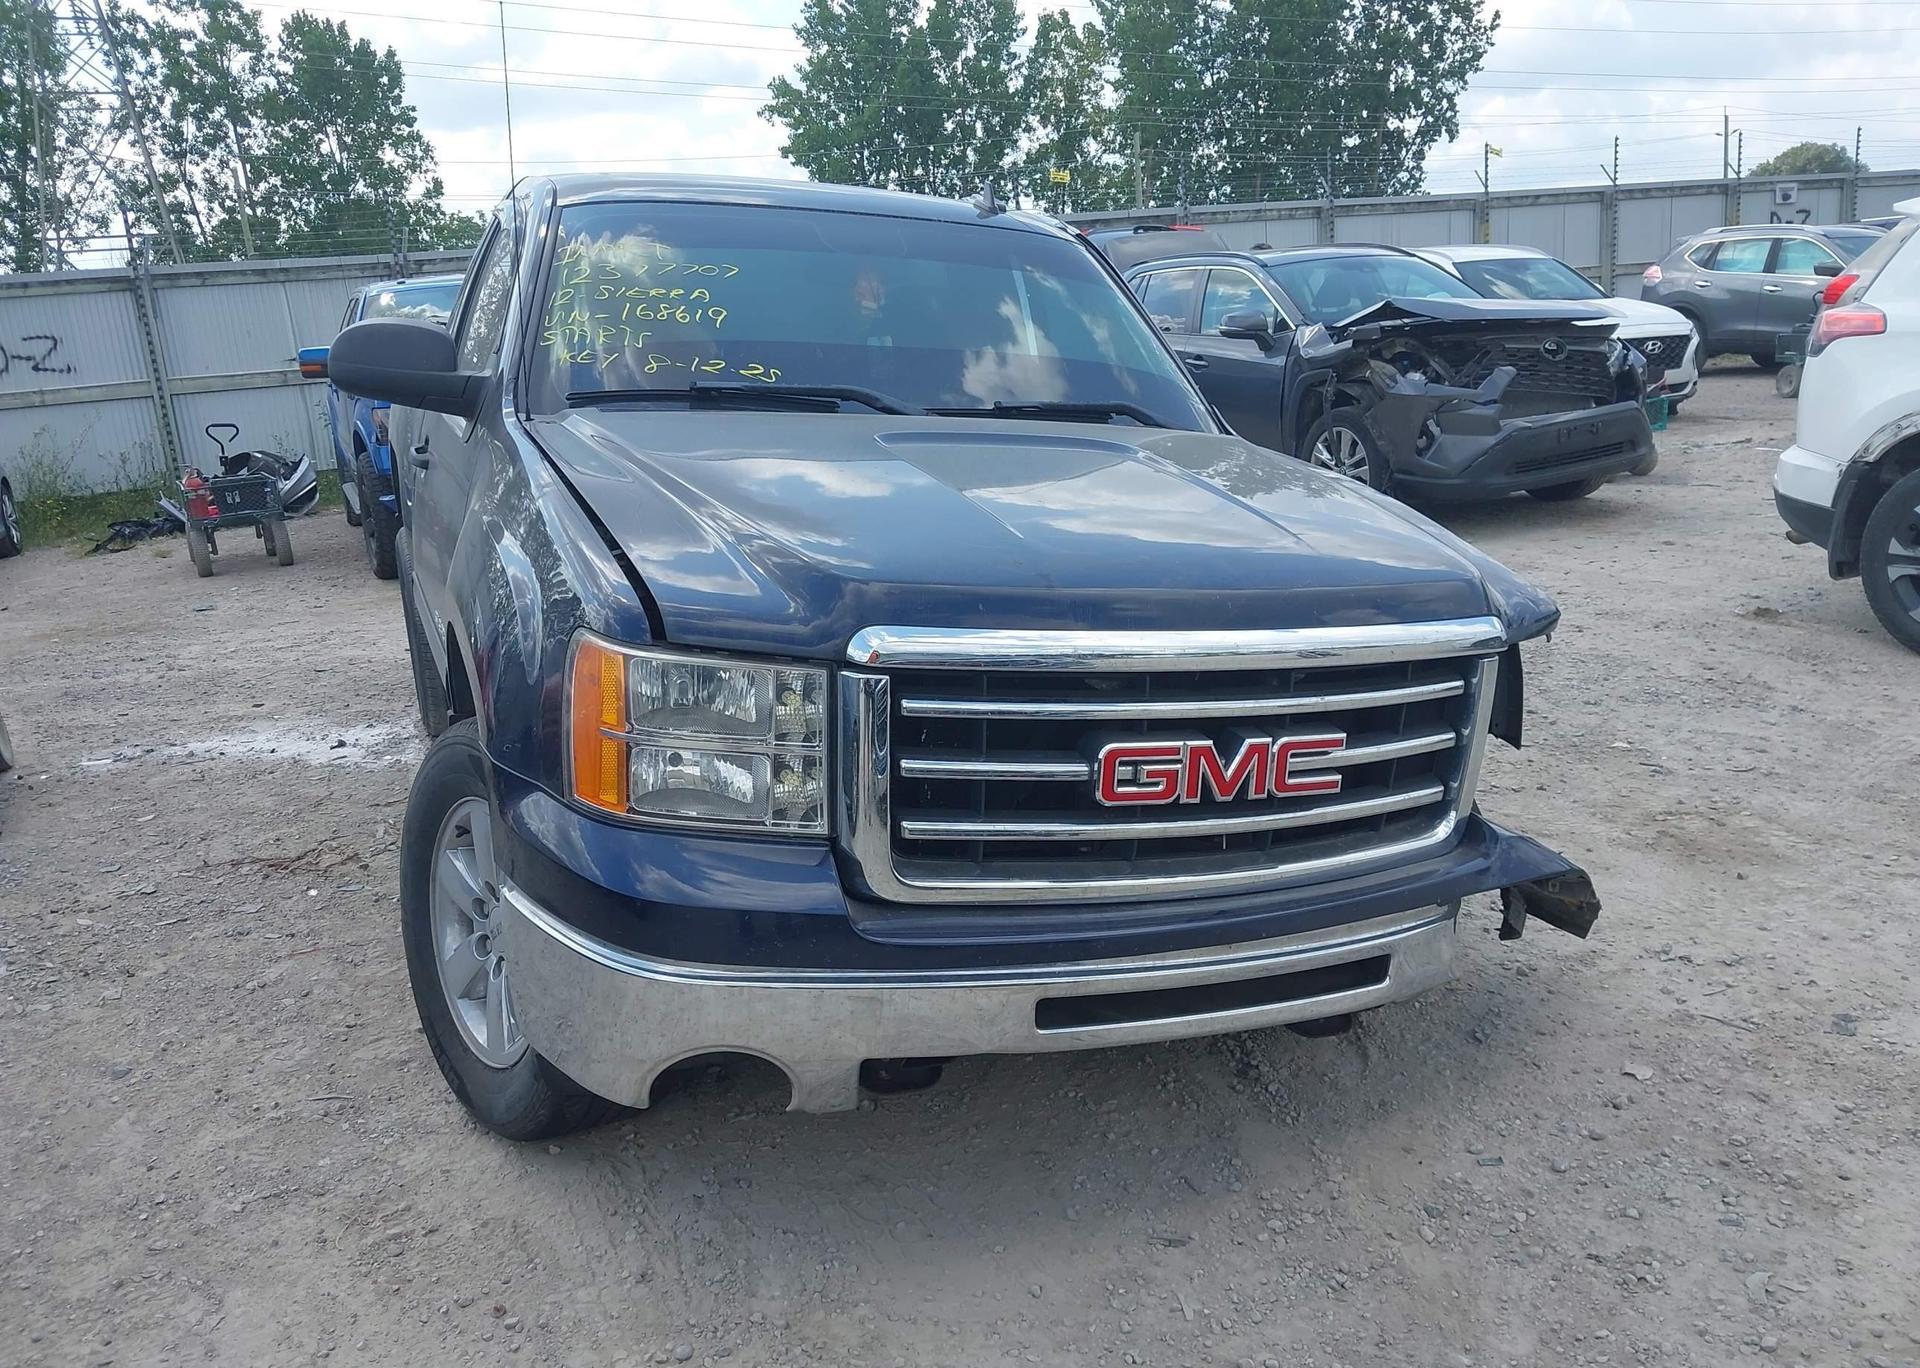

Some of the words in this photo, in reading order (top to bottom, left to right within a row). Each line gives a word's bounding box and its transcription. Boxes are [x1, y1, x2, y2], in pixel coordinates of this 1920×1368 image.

[540, 325, 652, 348] STARTS
[560, 350, 620, 369] KEY
[1095, 733, 1347, 806] GMC
